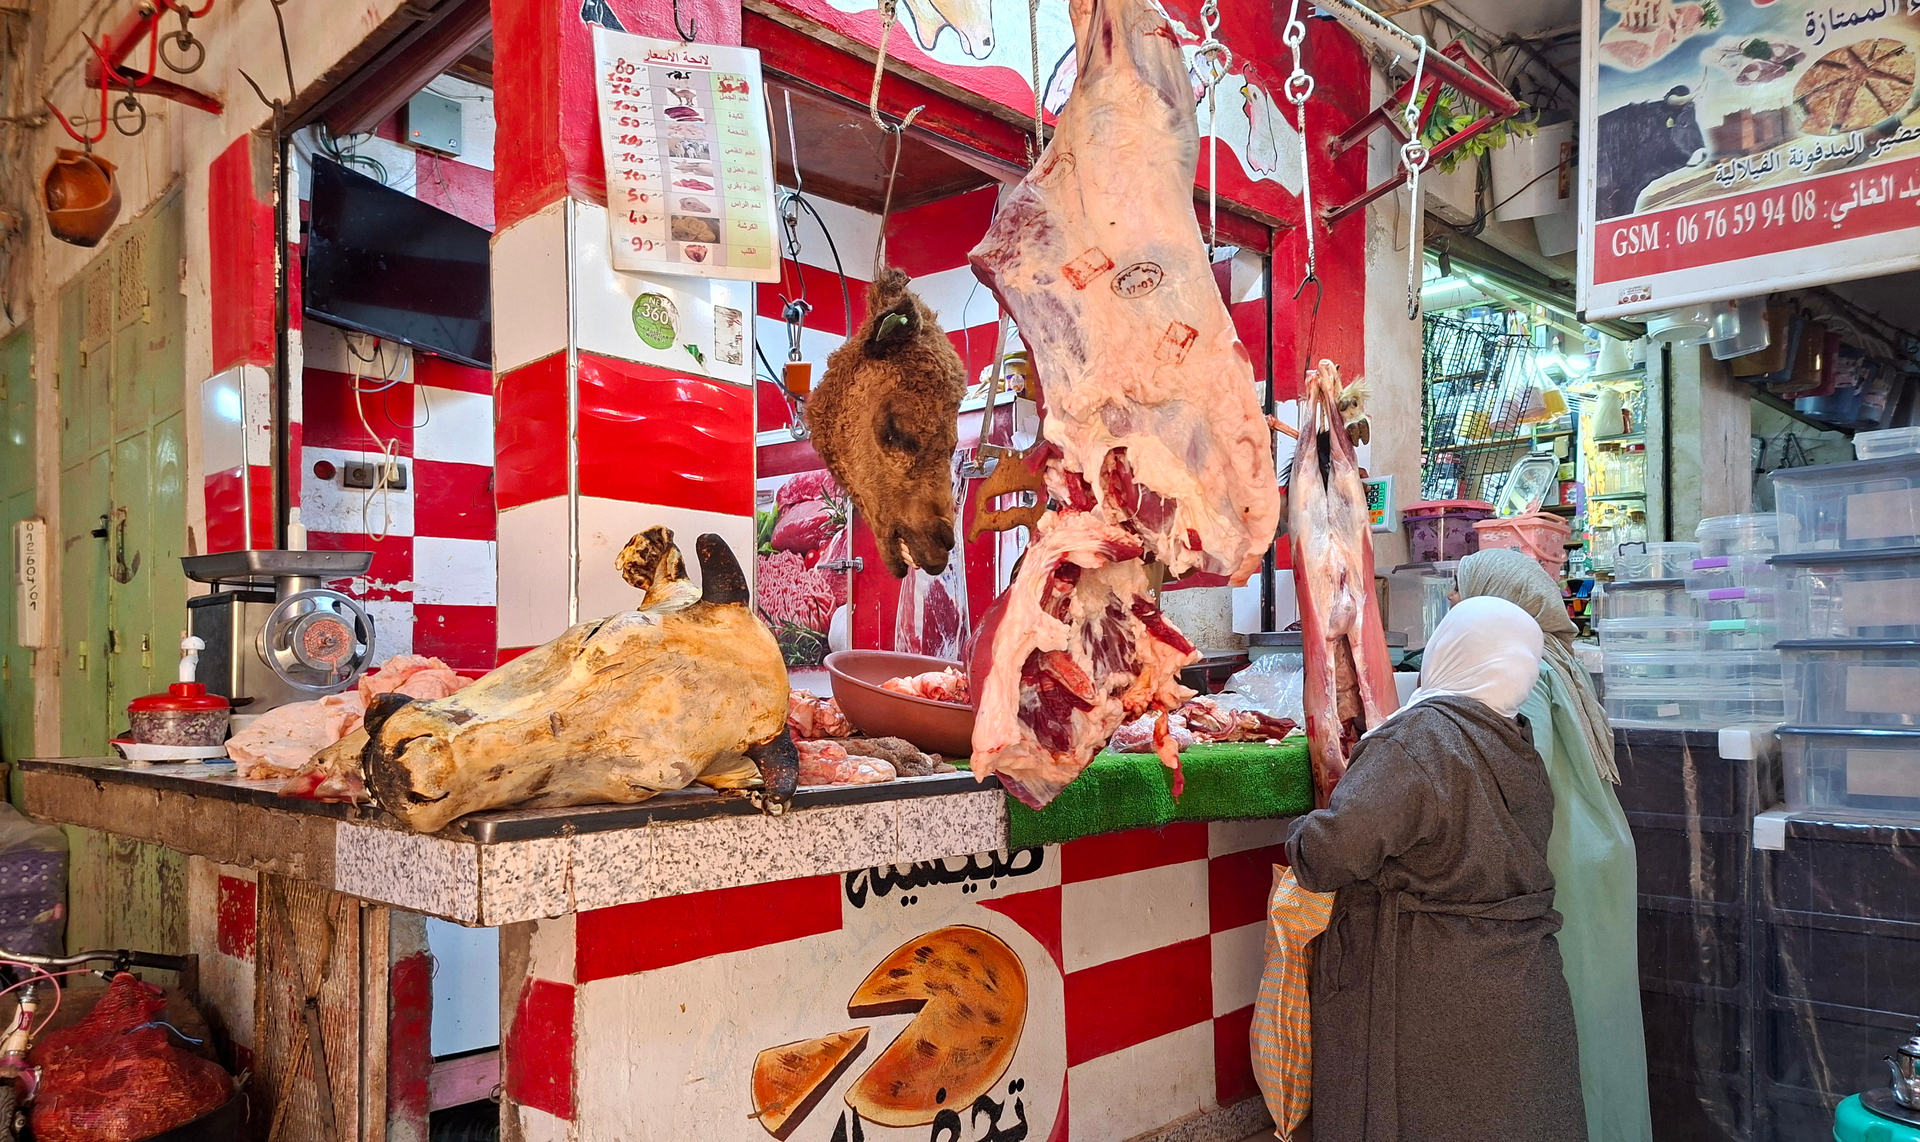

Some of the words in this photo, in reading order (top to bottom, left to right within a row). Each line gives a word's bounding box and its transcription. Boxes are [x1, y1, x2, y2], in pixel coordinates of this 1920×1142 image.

[1806, 0, 1896, 45] الممتازة
[644, 49, 679, 62] الأسعار
[683, 52, 709, 65] لائحة
[618, 116, 640, 128] 50
[1788, 131, 1864, 171] المدفونة
[1870, 126, 1920, 157] حضير
[1714, 151, 1780, 186] الفيلالية
[628, 188, 649, 203] 50
[1612, 222, 1660, 257] GSM
[1676, 216, 1699, 245] 06
[1705, 208, 1727, 240] 76
[1733, 201, 1756, 235] 59
[1762, 195, 1785, 230] 94
[1792, 189, 1816, 223] 08
[632, 237, 653, 252] 90
[642, 303, 669, 325] 360
